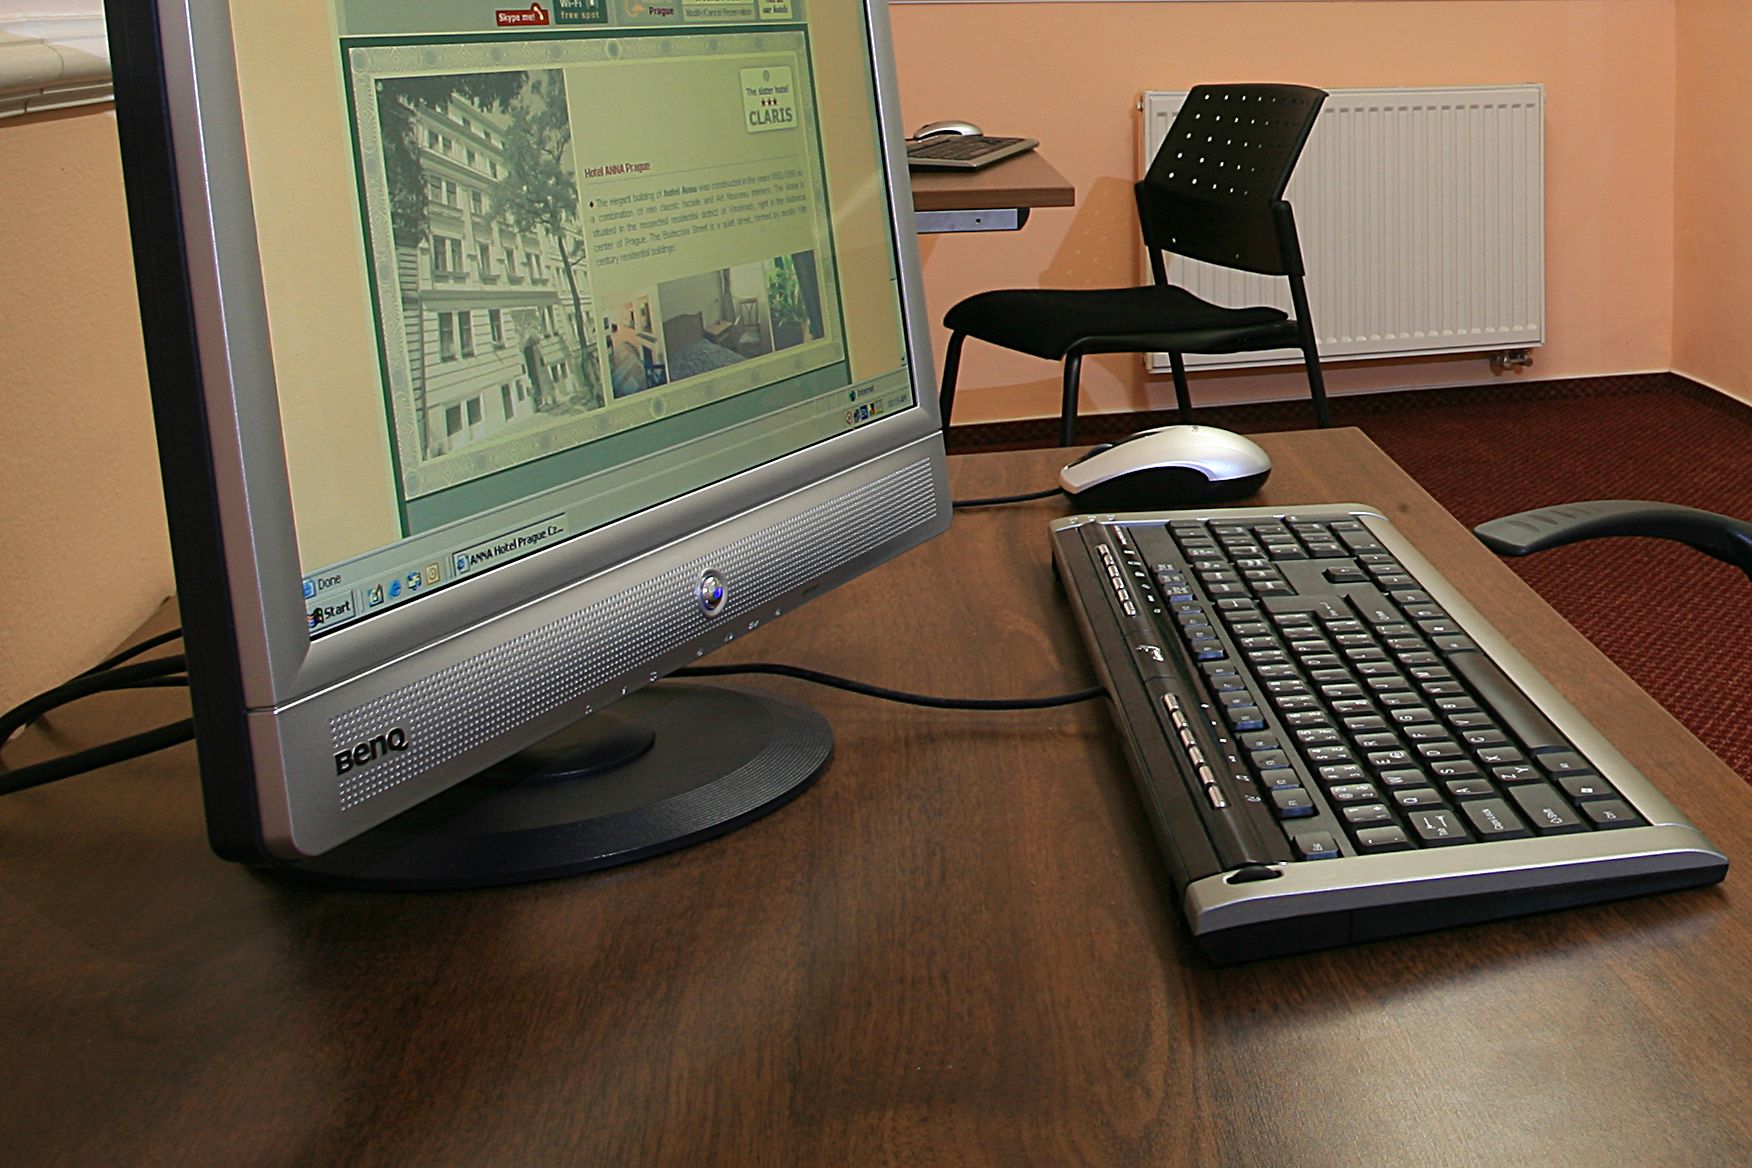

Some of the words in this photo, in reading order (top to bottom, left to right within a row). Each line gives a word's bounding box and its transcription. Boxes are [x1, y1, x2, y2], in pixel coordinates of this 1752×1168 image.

[500, 13, 521, 24] Skype
[522, 12, 535, 22] me!
[561, 11, 578, 20] free
[580, 11, 600, 21] spot
[649, 6, 674, 17] Prague
[746, 87, 758, 96] The
[749, 108, 793, 125] CLARIS
[585, 168, 603, 178] Hotel
[605, 164, 625, 175] ANNA
[626, 162, 651, 174] Prague
[470, 548, 495, 566] ANNA
[493, 539, 517, 557] Hotel
[518, 530, 547, 549] Prague
[318, 573, 342, 590] Done
[324, 601, 350, 620] Start
[333, 727, 409, 776] BenQ
